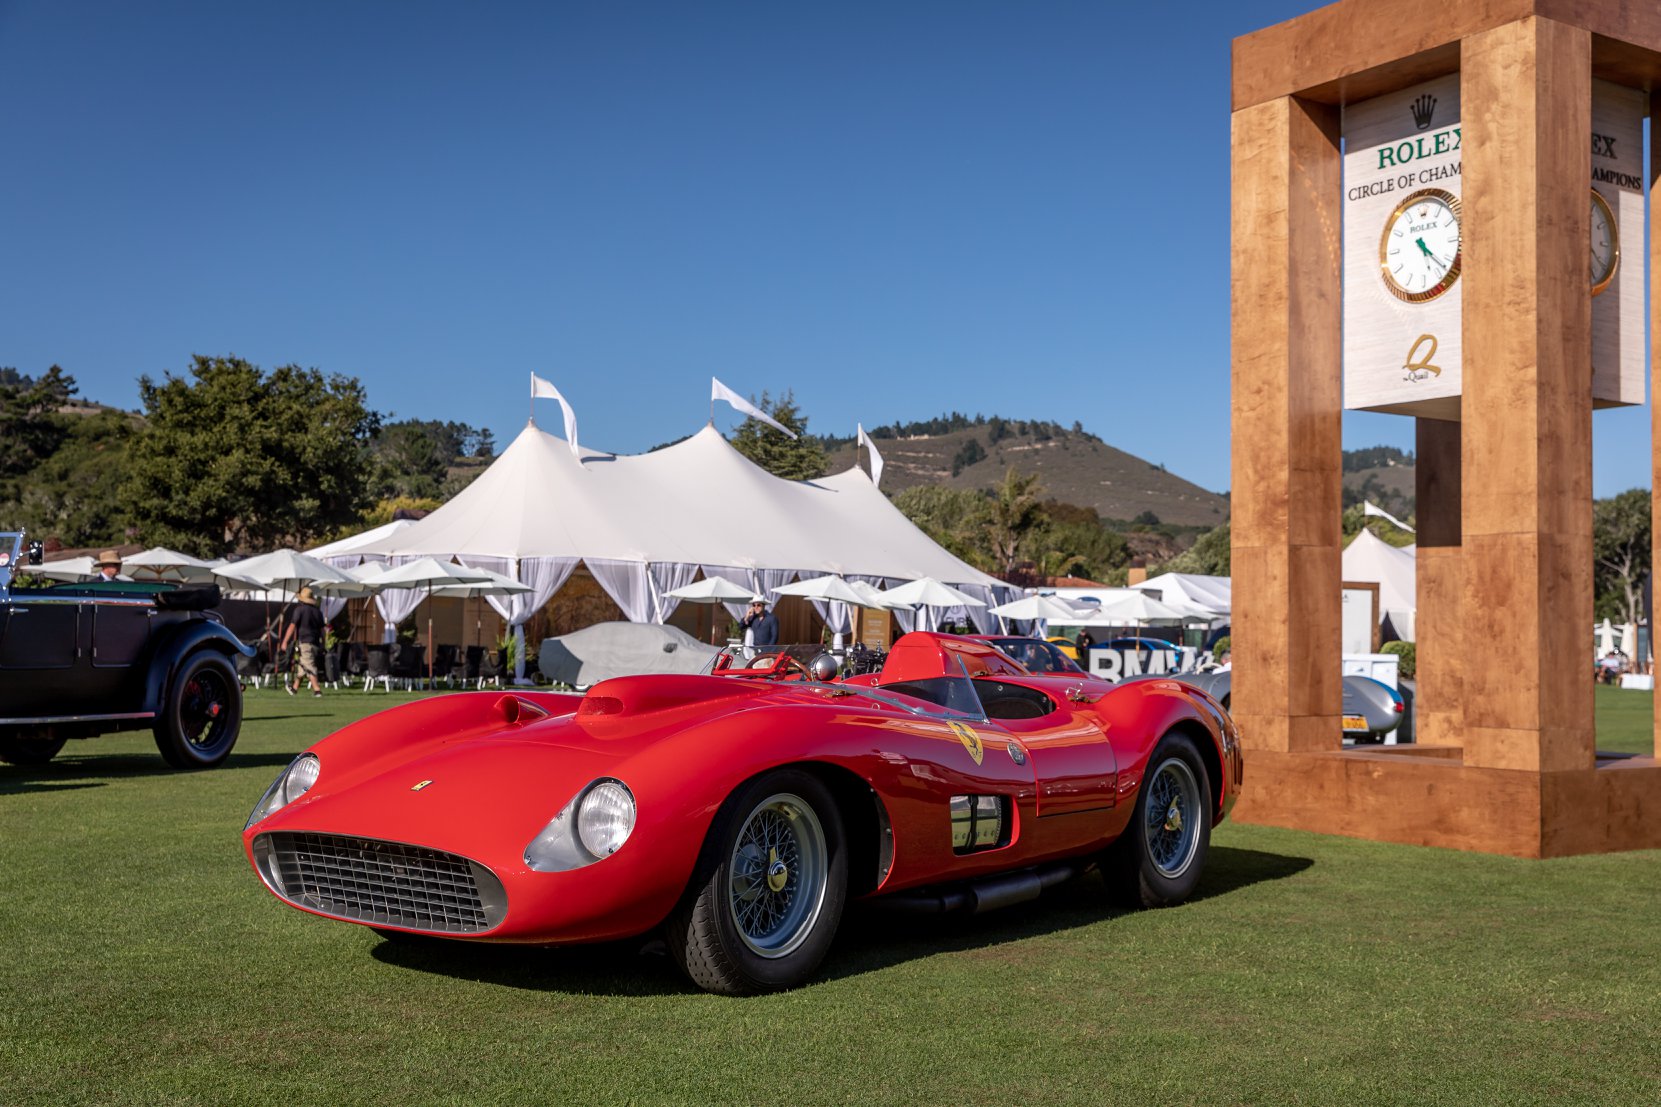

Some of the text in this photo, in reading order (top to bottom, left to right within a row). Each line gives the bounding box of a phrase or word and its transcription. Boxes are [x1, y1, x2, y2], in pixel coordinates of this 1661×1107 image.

[1348, 178, 1395, 201] CIRCLE
[1397, 173, 1416, 189] OF
[1591, 167, 1641, 190] AMPIONS
[1409, 221, 1438, 233] ROLEX
[1089, 646, 1214, 684] BMW
